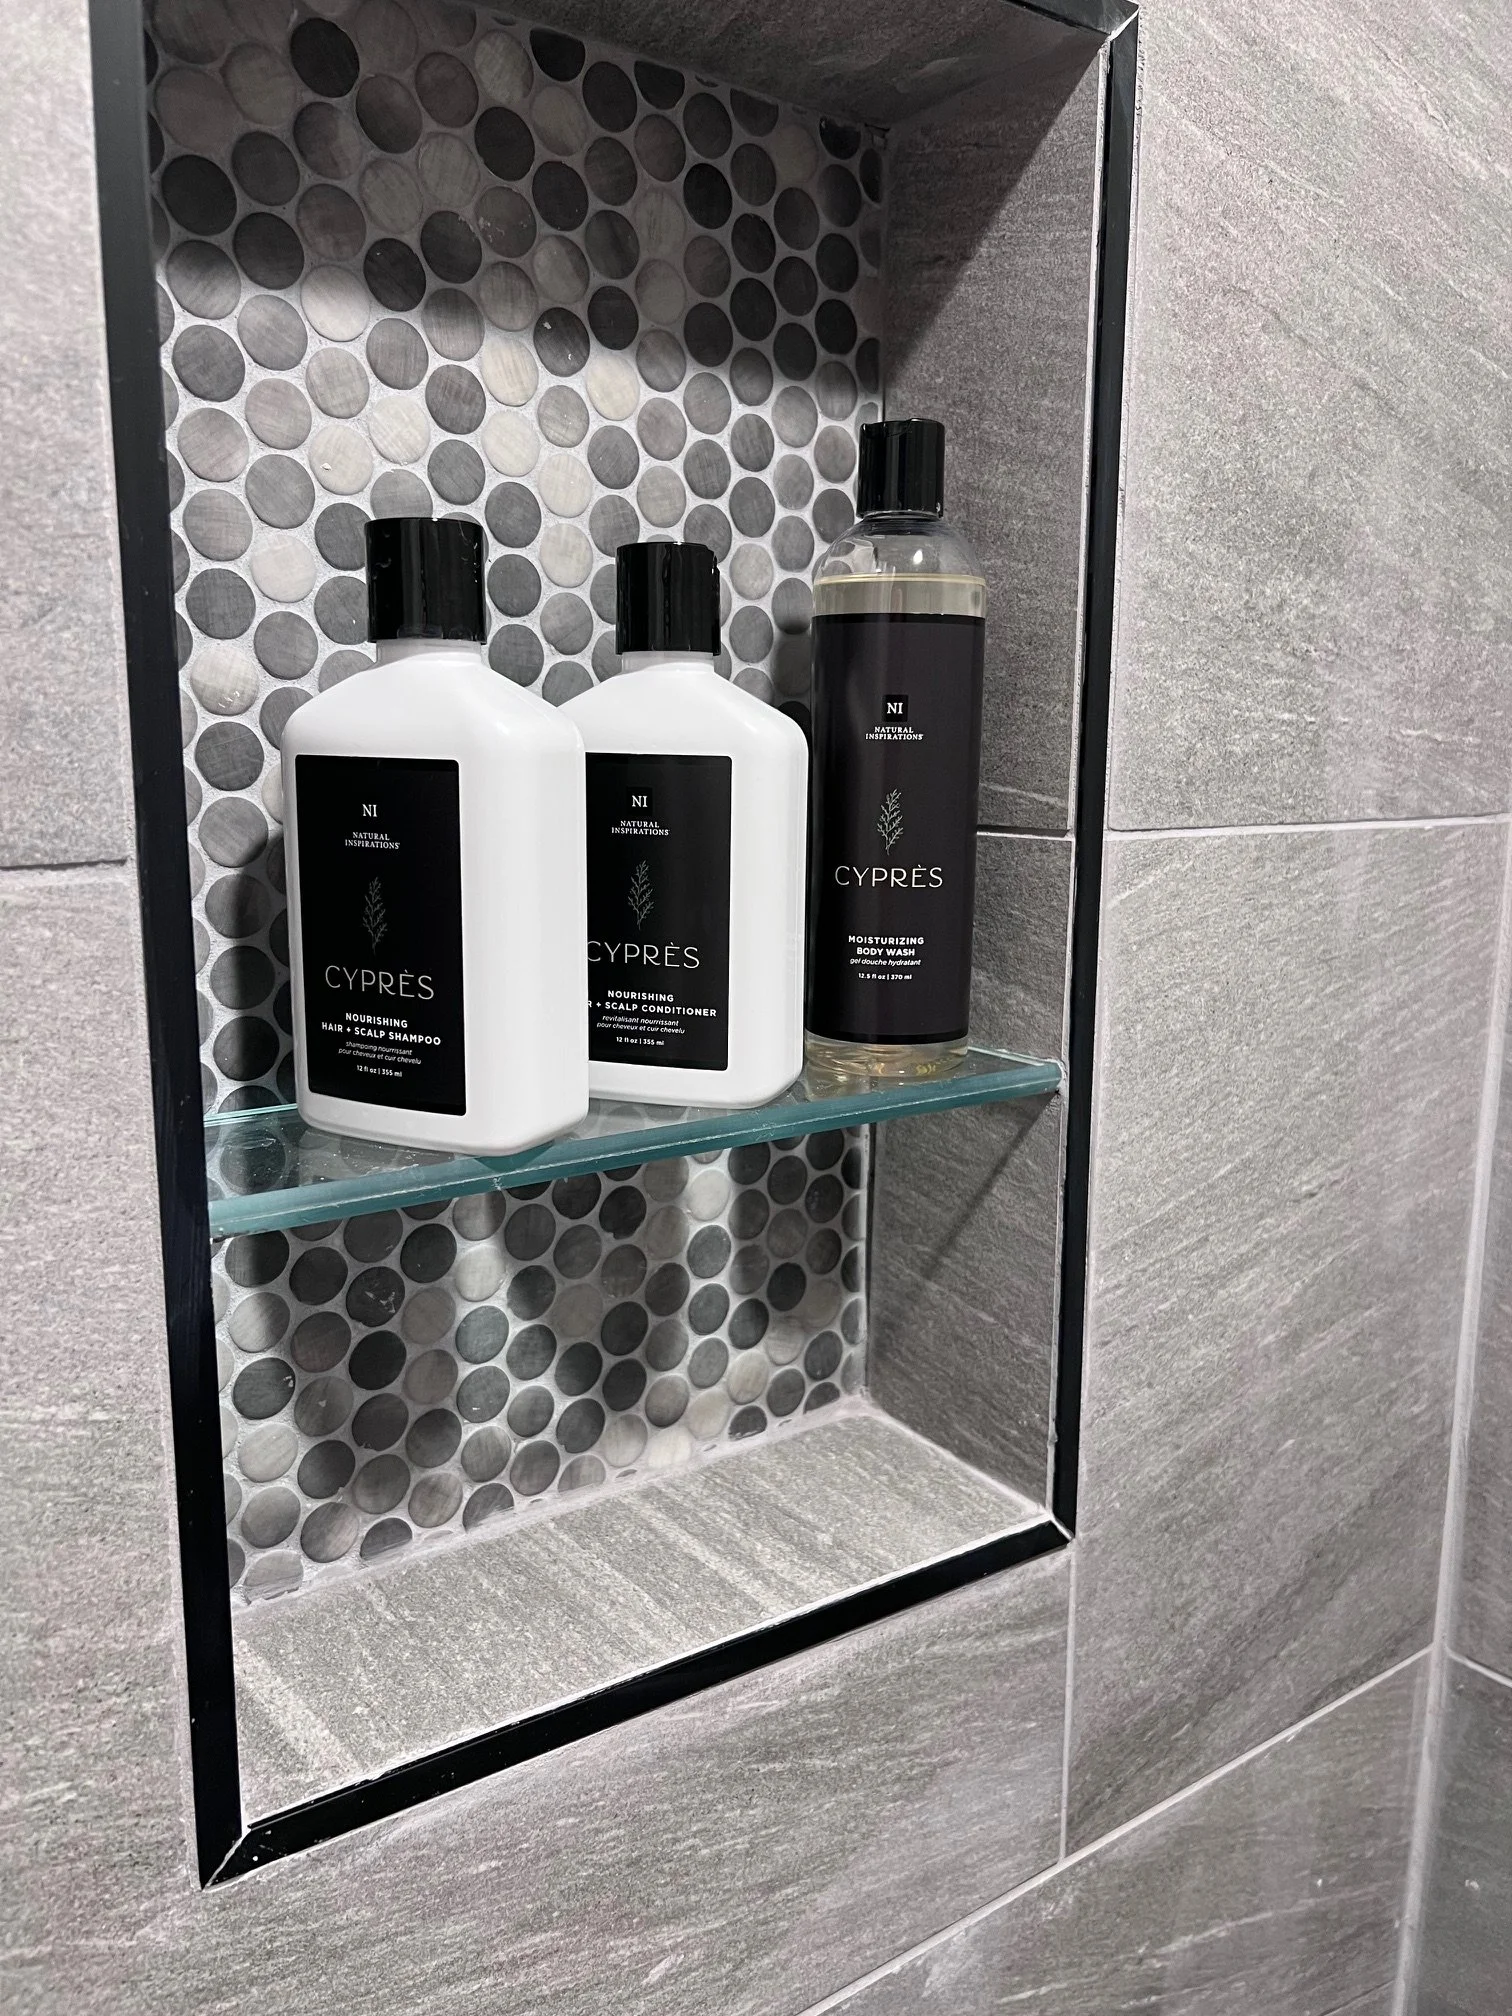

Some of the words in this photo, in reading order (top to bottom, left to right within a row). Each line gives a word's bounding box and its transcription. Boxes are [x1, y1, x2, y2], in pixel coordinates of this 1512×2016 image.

[887, 702, 903, 714] NI
[866, 733, 923, 741] INSPIRATIONS
[632, 795, 648, 807] NI
[362, 804, 378, 817] NI
[621, 820, 659, 828] NATURAL
[353, 832, 390, 841] NATURAL
[612, 827, 670, 836] INSPIRATIONS
[345, 839, 400, 849] INSPIRATIONS
[835, 864, 943, 888] CYPRÈS
[848, 936, 925, 945] MOISTURIZING
[588, 941, 700, 969] CYPRÈS
[857, 947, 883, 956] BODY
[886, 948, 915, 956] WASH
[325, 965, 434, 1000] CYPRÈS
[608, 990, 674, 1002] NOURISHING
[605, 1002, 638, 1011] SCALP
[642, 1005, 717, 1017] CONDITIONER
[346, 1013, 408, 1028] NOURISHING
[602, 1015, 639, 1023] revitalisant
[641, 1018, 679, 1027] nourrissant
[613, 1023, 638, 1031] cheveux
[322, 1022, 343, 1032] HAIR
[355, 1027, 385, 1038] SCALP
[389, 1032, 441, 1045] SHAMPOO
[346, 1041, 377, 1052] shampoing
[378, 1046, 412, 1055] nourrissant
[353, 1050, 376, 1059] cheveux
[397, 1056, 421, 1065] chevelu
